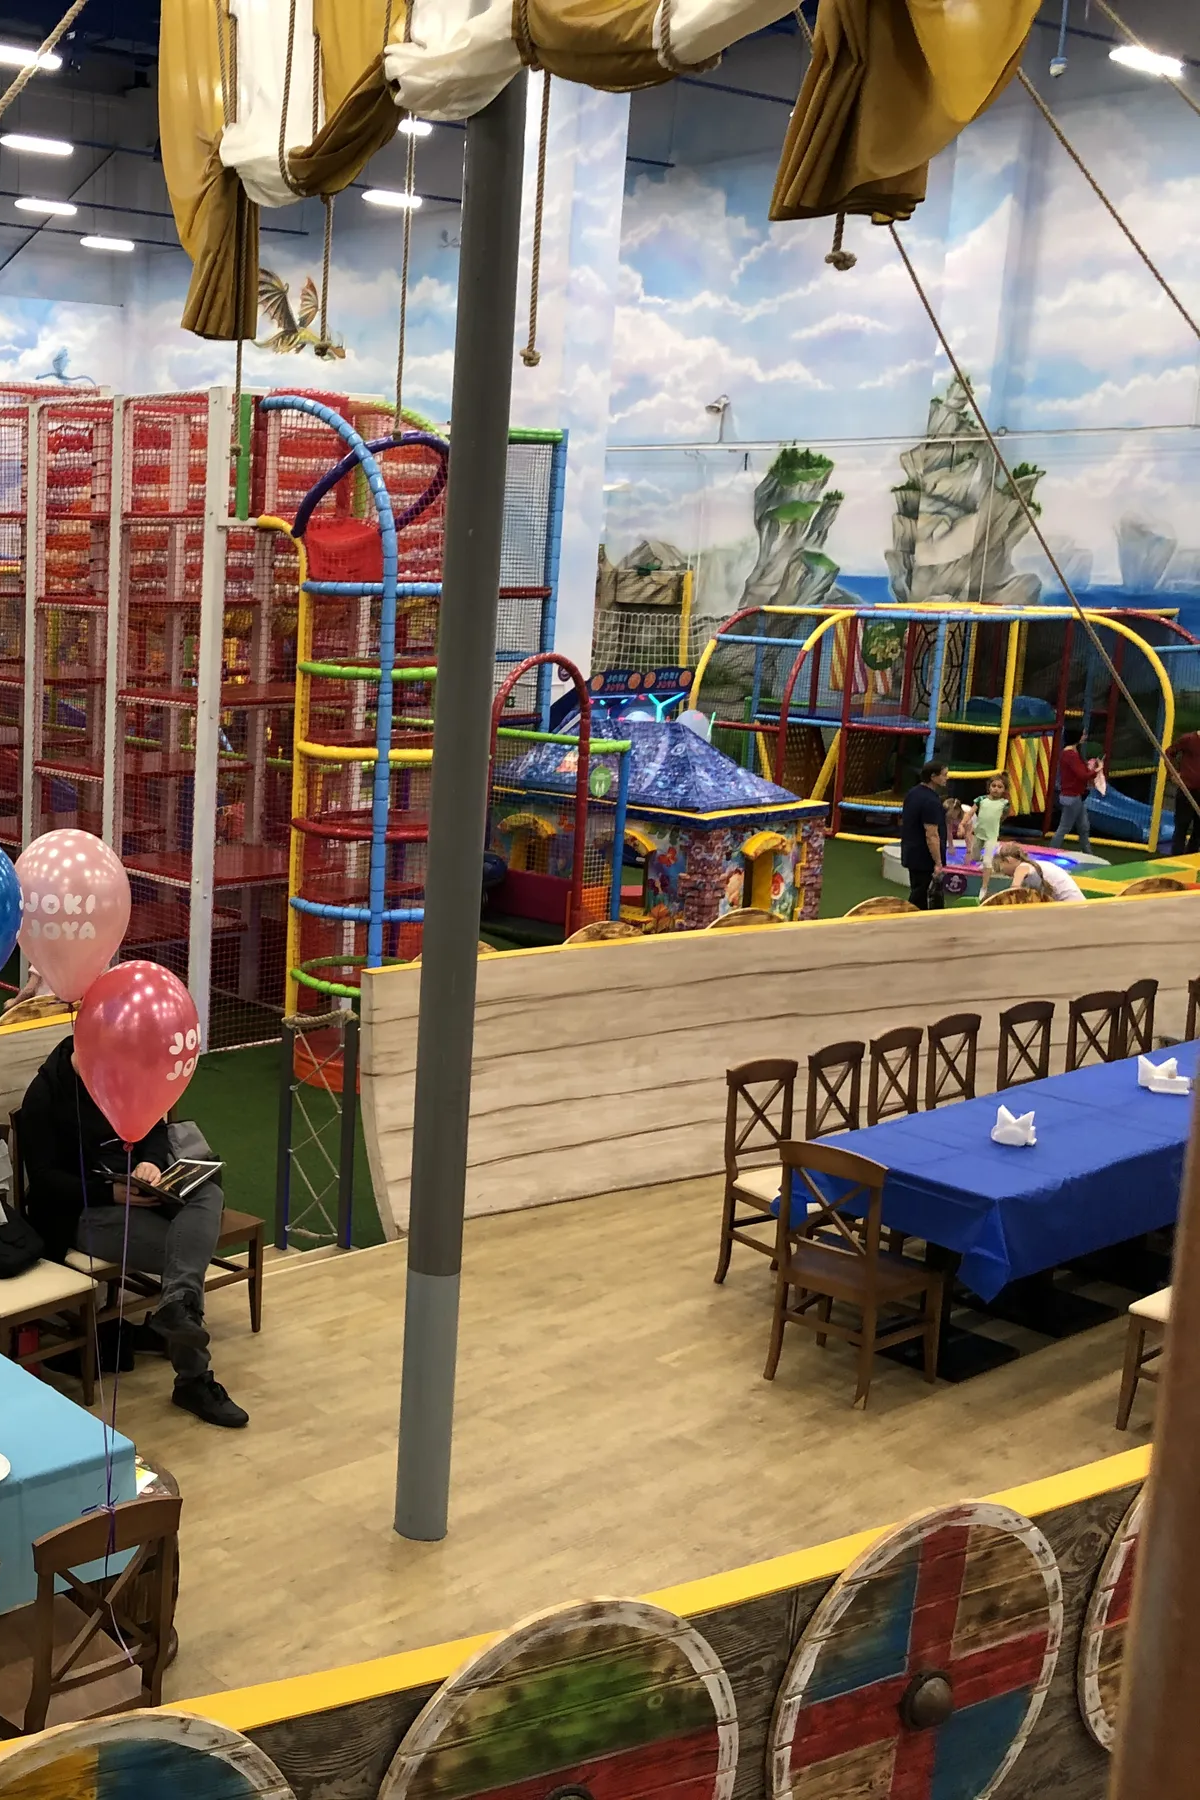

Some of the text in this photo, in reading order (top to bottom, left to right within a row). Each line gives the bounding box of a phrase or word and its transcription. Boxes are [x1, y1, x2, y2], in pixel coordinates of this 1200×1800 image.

[25, 891, 96, 915] JOKI
[27, 919, 96, 940] JOYA
[168, 1022, 200, 1055] JO
[165, 1053, 199, 1081] JO
